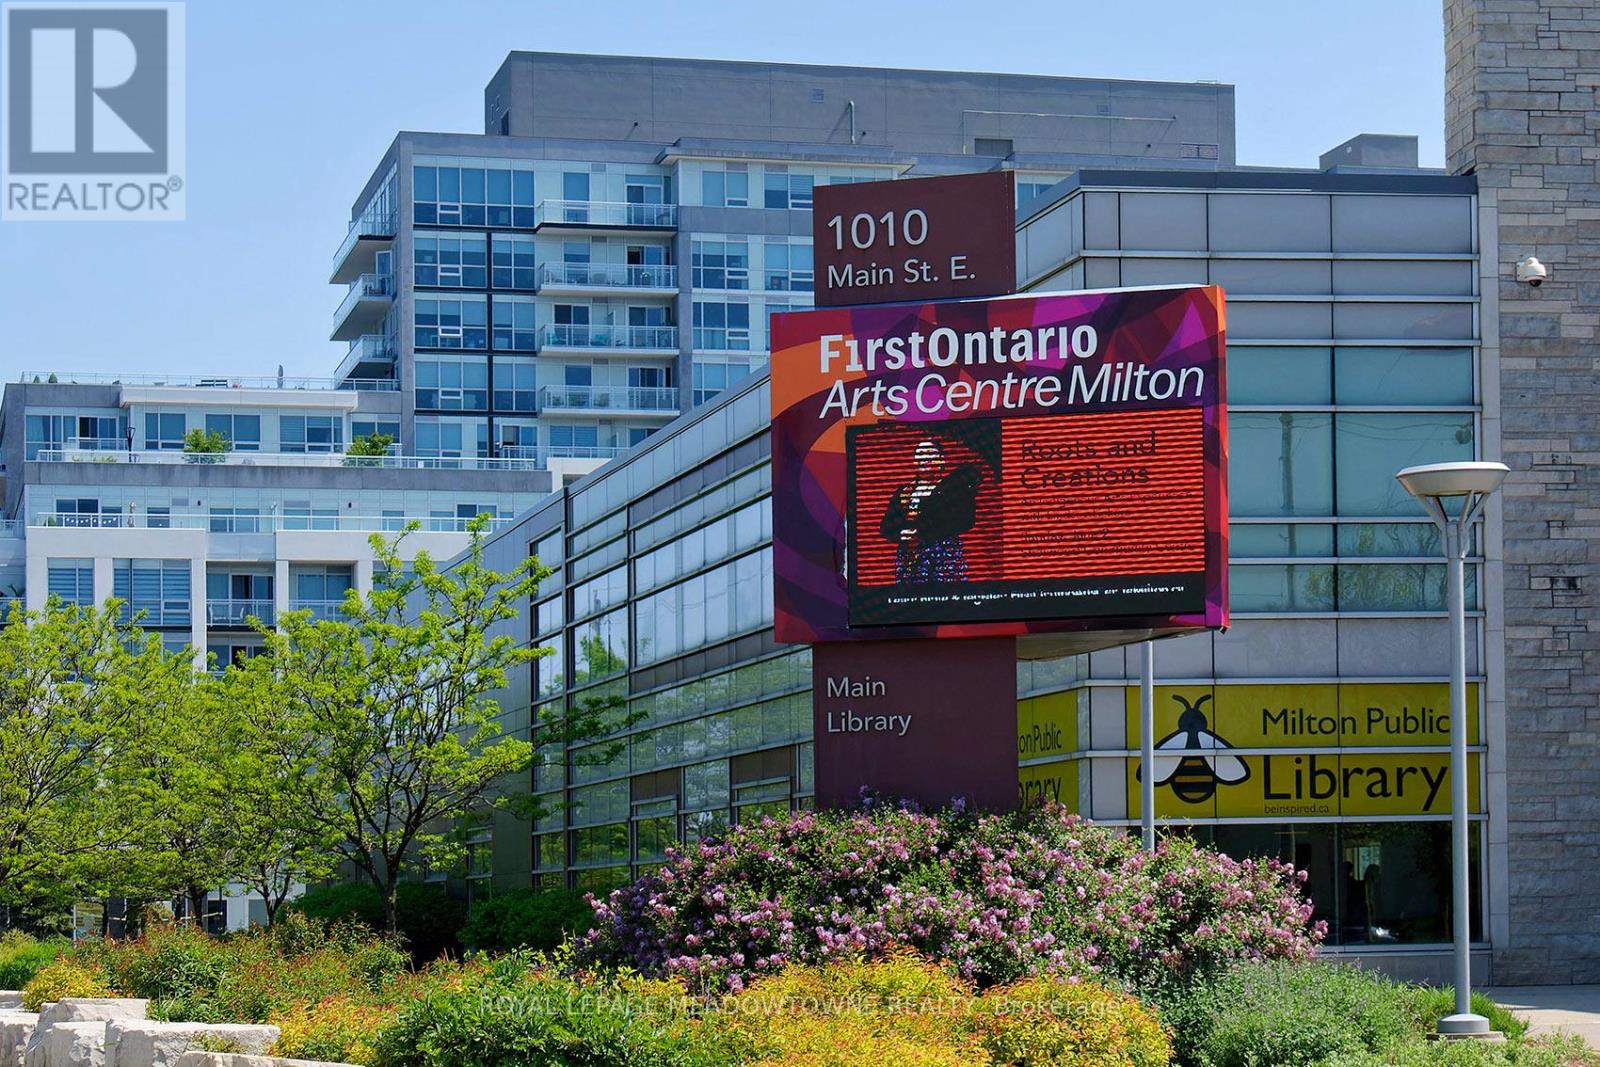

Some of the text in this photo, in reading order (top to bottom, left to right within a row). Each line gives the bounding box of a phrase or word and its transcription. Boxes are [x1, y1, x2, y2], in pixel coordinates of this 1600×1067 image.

[827, 209, 929, 251] 1010
[827, 256, 976, 289] Main St. E.
[819, 361, 1205, 419] Arts Centre Milton
[826, 677, 886, 698] Main
[827, 710, 912, 736] Library
[1262, 707, 1450, 736] Milton Public
[1033, 722, 1062, 753] Public
[1263, 754, 1449, 812] Library
[1264, 804, 1329, 814] beinspired.ca
